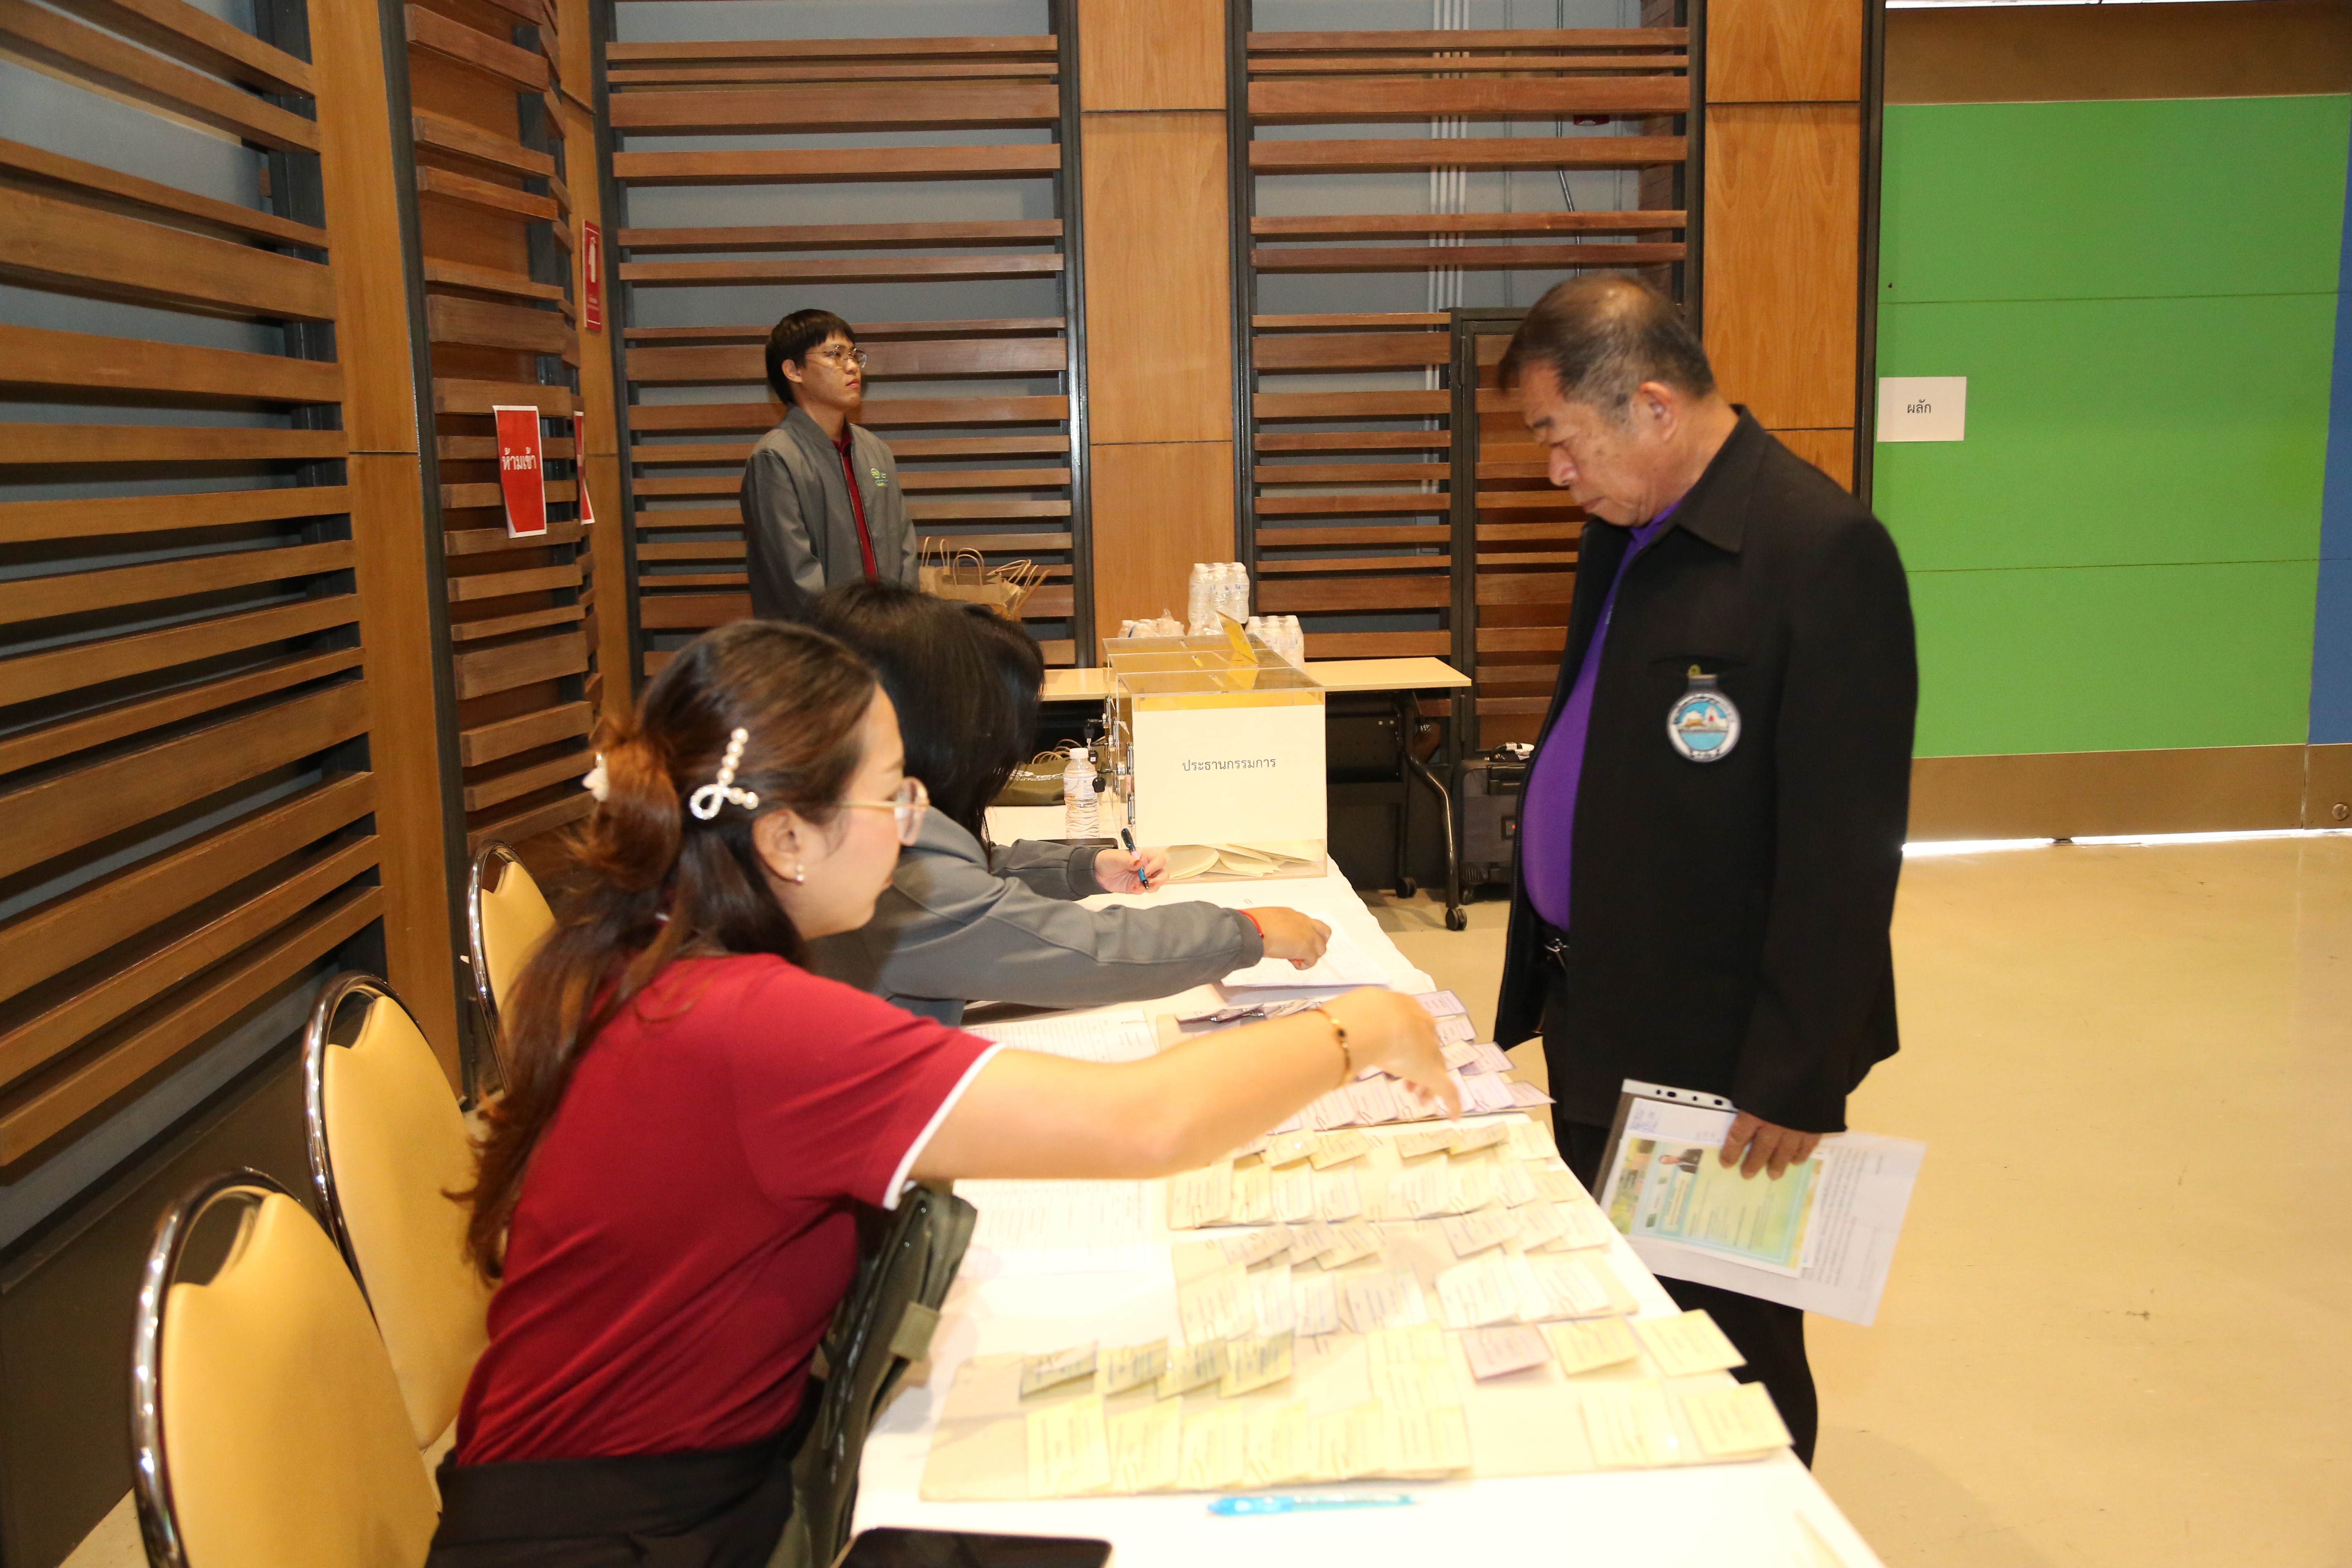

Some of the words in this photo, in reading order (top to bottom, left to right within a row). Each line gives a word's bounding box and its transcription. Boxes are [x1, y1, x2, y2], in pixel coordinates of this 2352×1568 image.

[1907, 399, 1931, 413] ผลัก
[501, 447, 537, 471] ห้ามเข้า
[1182, 759, 1276, 771] ประธานกรรมการ
